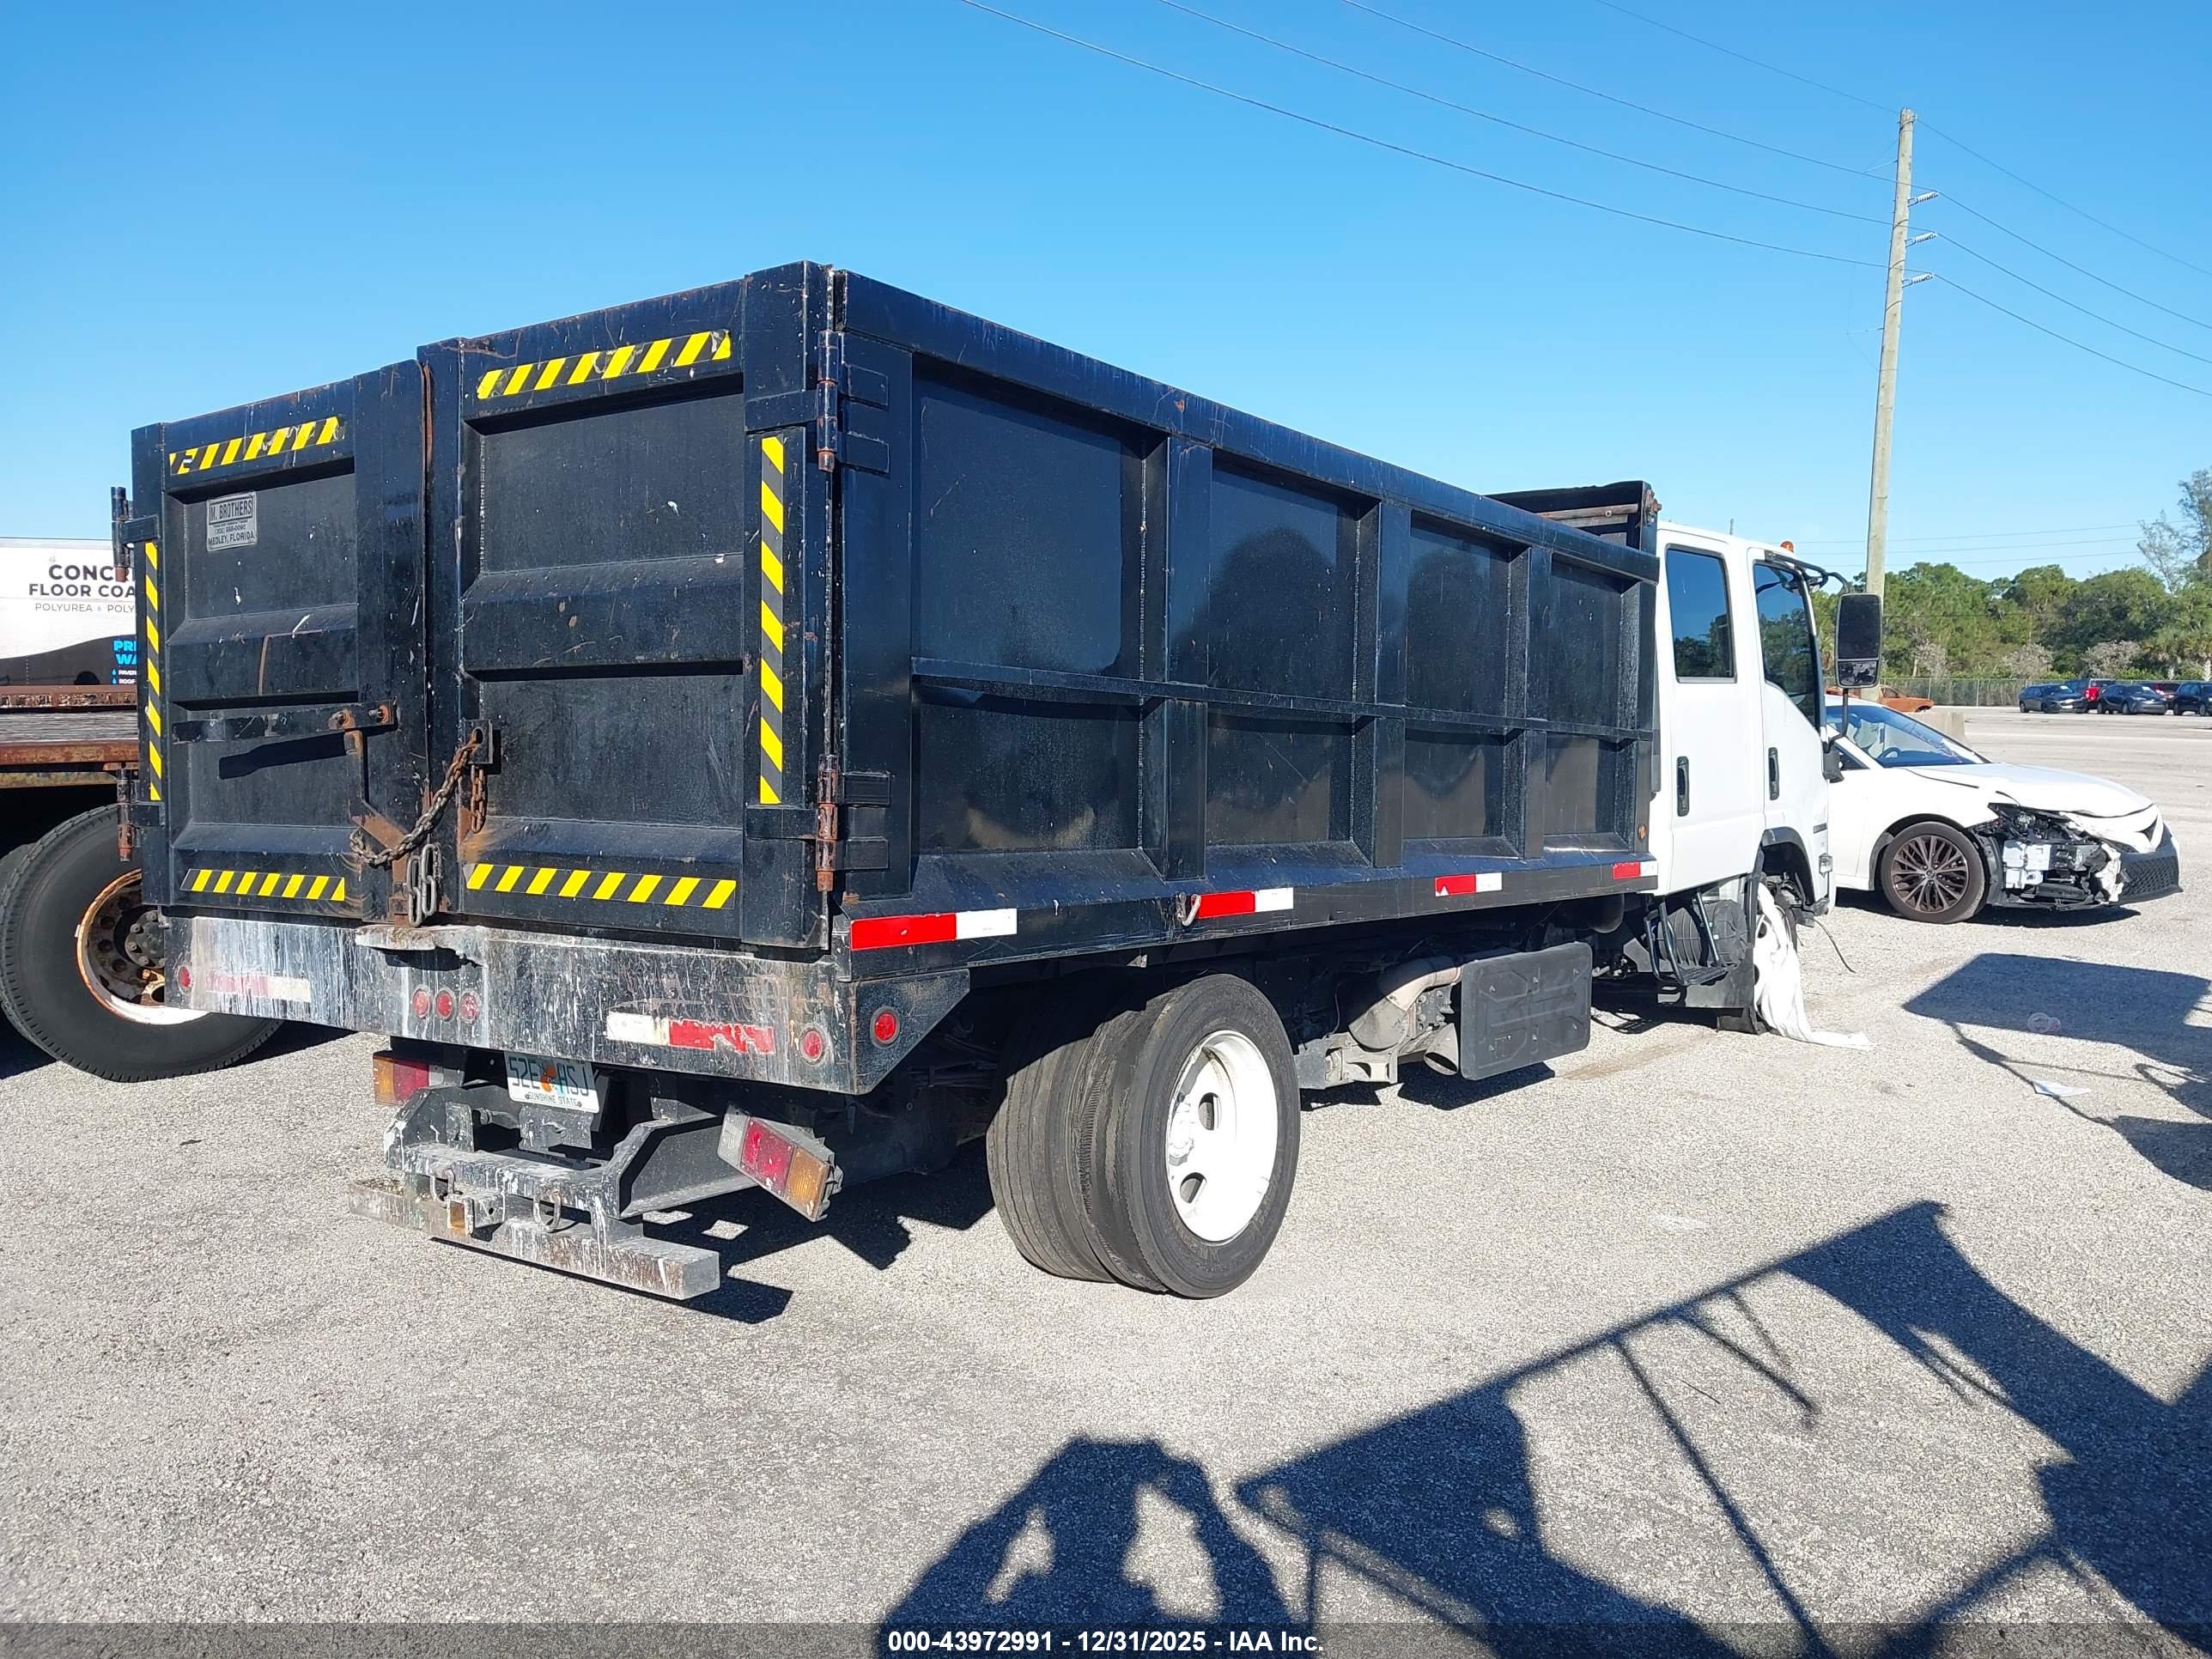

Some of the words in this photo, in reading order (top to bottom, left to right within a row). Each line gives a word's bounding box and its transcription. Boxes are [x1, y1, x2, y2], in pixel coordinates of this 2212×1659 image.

[219, 499, 252, 519] BROTHERS
[229, 531, 254, 542] FLORIDA
[29, 583, 91, 597] FLOOR
[35, 603, 93, 612] POLYUREA
[528, 1091, 556, 1104] SUNSHINE
[559, 1097, 579, 1107] STATE
